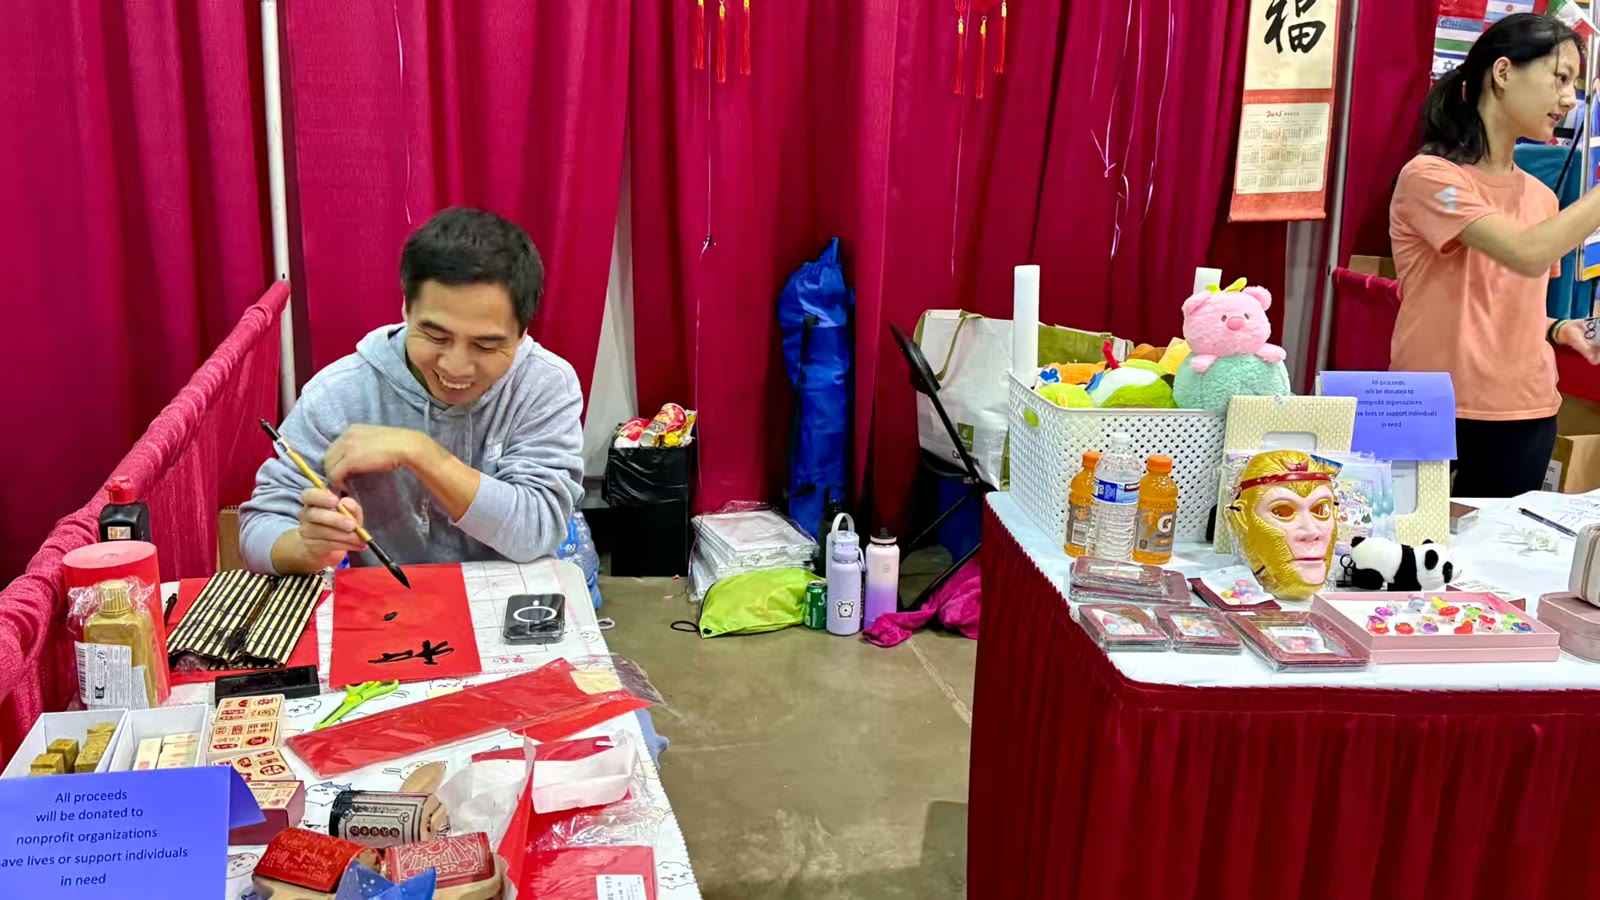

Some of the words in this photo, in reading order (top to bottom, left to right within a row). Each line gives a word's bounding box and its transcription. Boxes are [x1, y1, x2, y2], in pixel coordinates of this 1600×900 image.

[1264, 0, 1327, 54] 福
[1385, 399, 1423, 407] organizations
[55, 792, 71, 804] All
[74, 789, 128, 805] proceeds
[35, 810, 57, 823] will
[60, 809, 75, 822] be
[78, 807, 128, 821] donated
[131, 807, 144, 818] to
[16, 831, 75, 846] nonprofit
[78, 828, 158, 844] organizations
[0, 858, 24, 868] ave
[27, 855, 55, 866] lives
[58, 856, 72, 865] or
[75, 852, 122, 866] support
[125, 846, 188, 861] individuals
[60, 875, 72, 887] in
[75, 873, 107, 886] need
